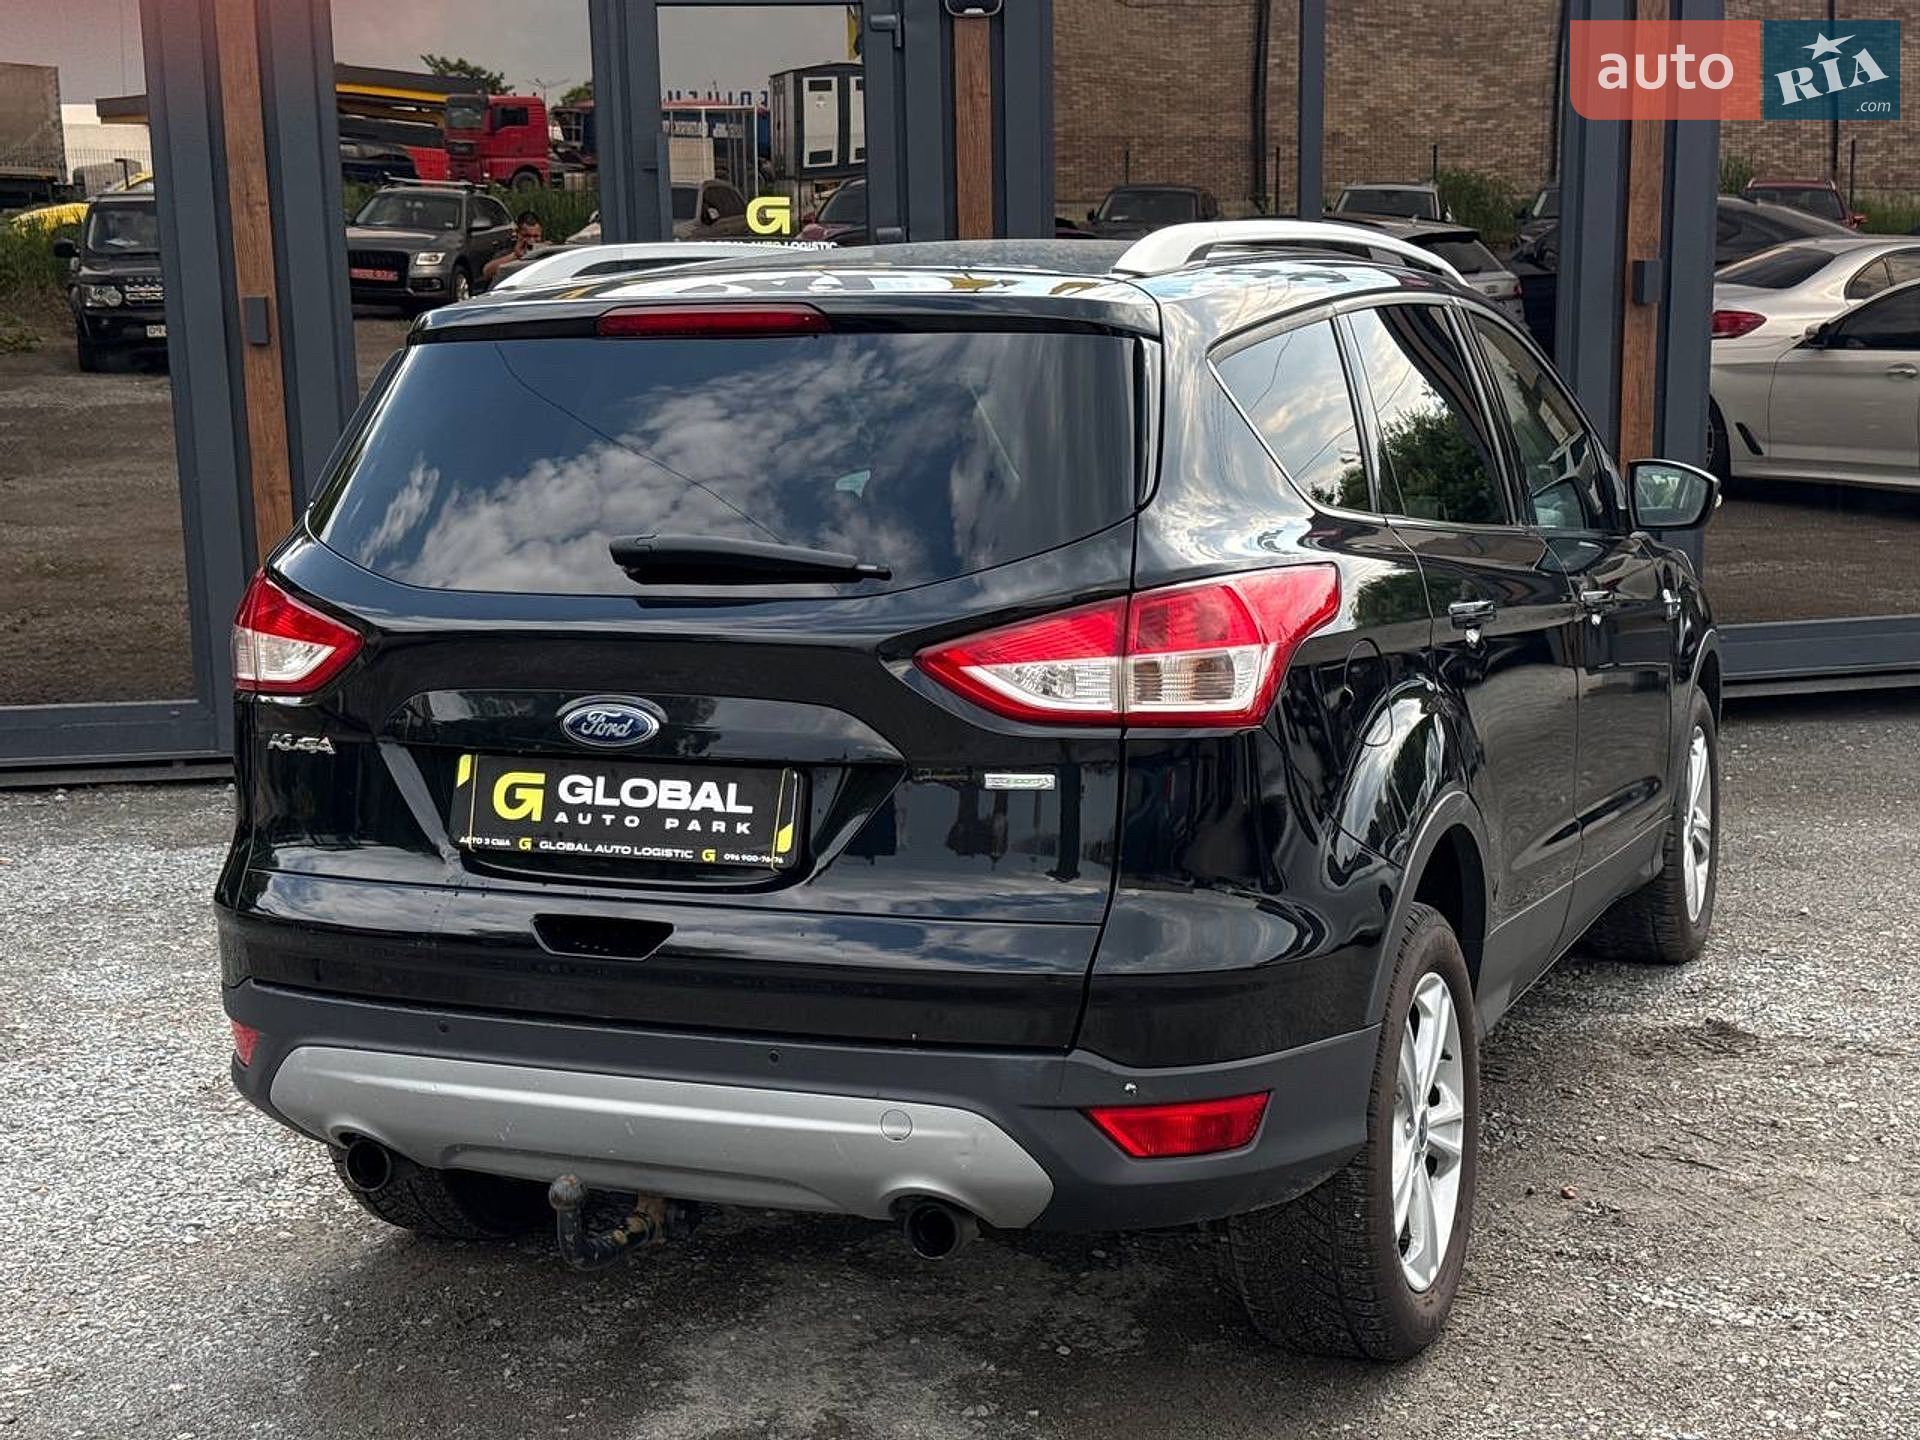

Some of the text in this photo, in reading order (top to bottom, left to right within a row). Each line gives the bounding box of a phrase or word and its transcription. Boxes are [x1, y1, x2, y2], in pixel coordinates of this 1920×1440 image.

[580, 710, 634, 738] Ford
[557, 774, 753, 814] GLOBAL
[554, 812, 752, 835] AUTO PARK
[539, 841, 693, 859] GLOBAL AUTO LOGISTIC
